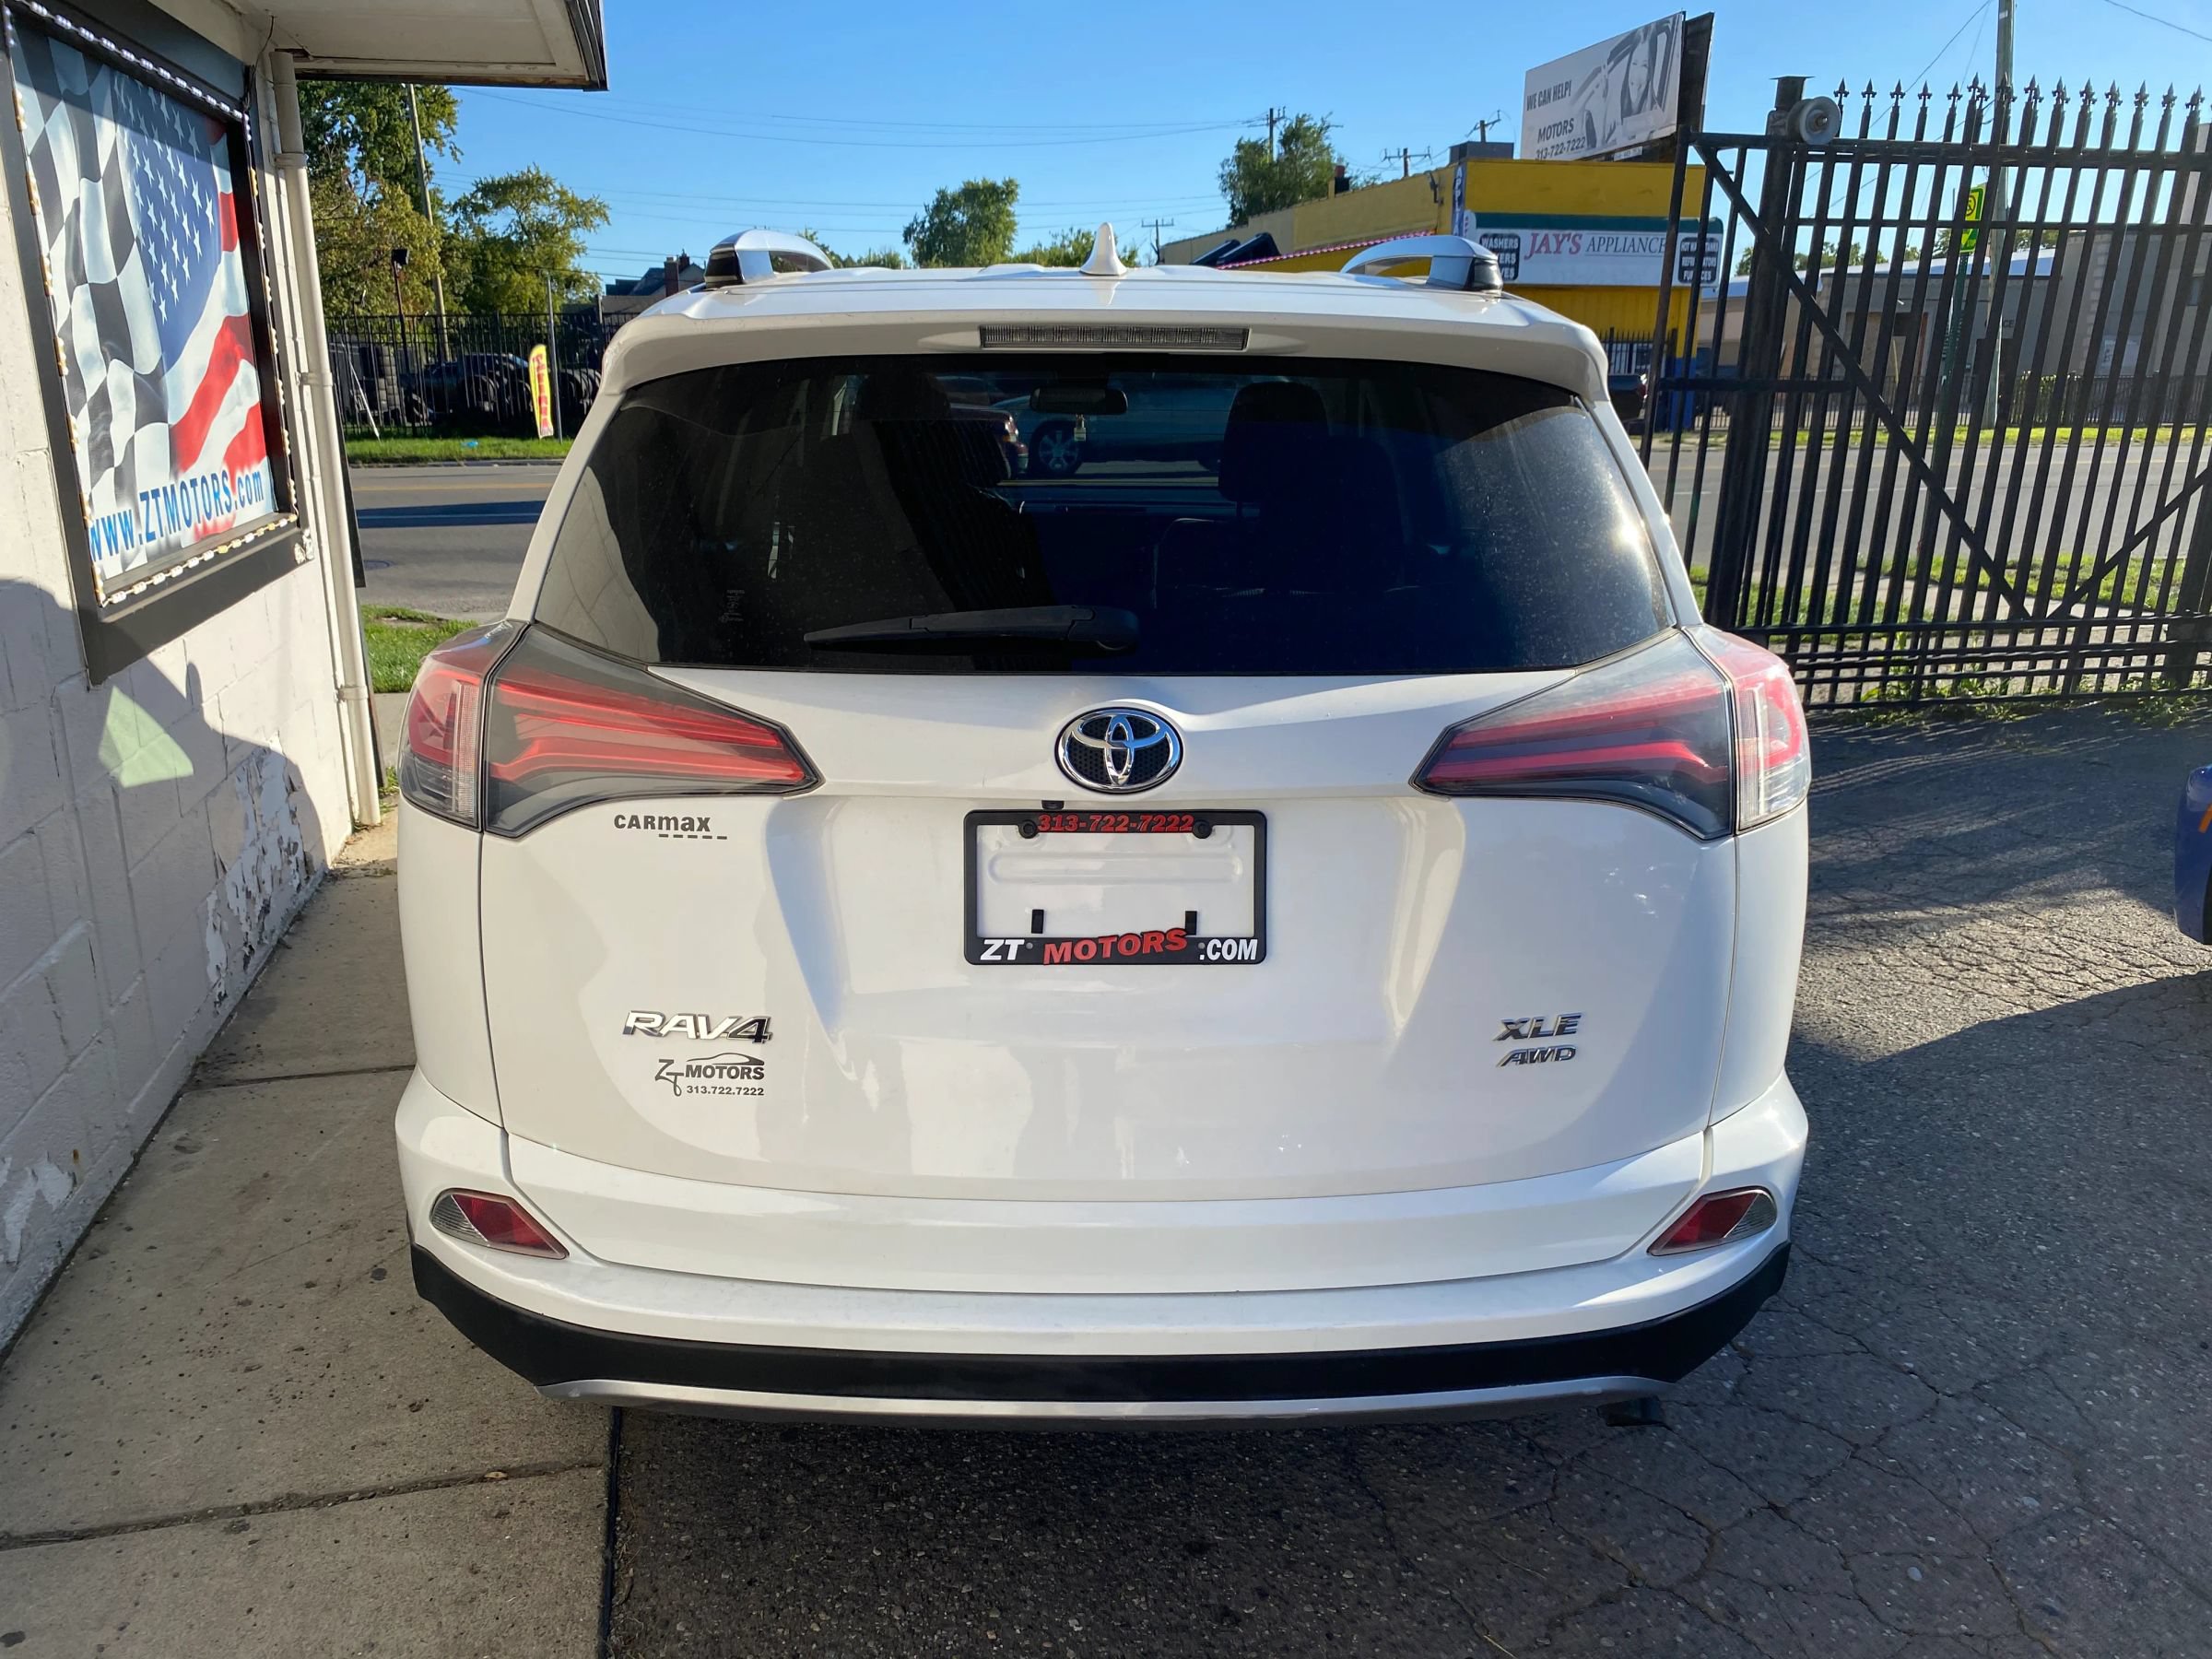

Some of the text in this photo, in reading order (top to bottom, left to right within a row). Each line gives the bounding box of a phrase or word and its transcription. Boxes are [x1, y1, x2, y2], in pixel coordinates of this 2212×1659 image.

[1526, 80, 1571, 111] WE CAN HELP!
[1537, 118, 1574, 144] MOTORS
[1535, 136, 1585, 161] 313-722-7222
[1481, 236, 1519, 249] WASHERS
[1524, 232, 1583, 260] JAY'S
[1037, 813, 1194, 833] 313-722-7222
[980, 927, 1258, 965] ZT MOTORS .COM
[622, 1010, 773, 1044] RAV4
[1491, 1012, 1583, 1041] XLE
[1496, 1044, 1576, 1067] AWD
[685, 1064, 765, 1080] MOTORS
[686, 1085, 765, 1096] 313.722.7222
